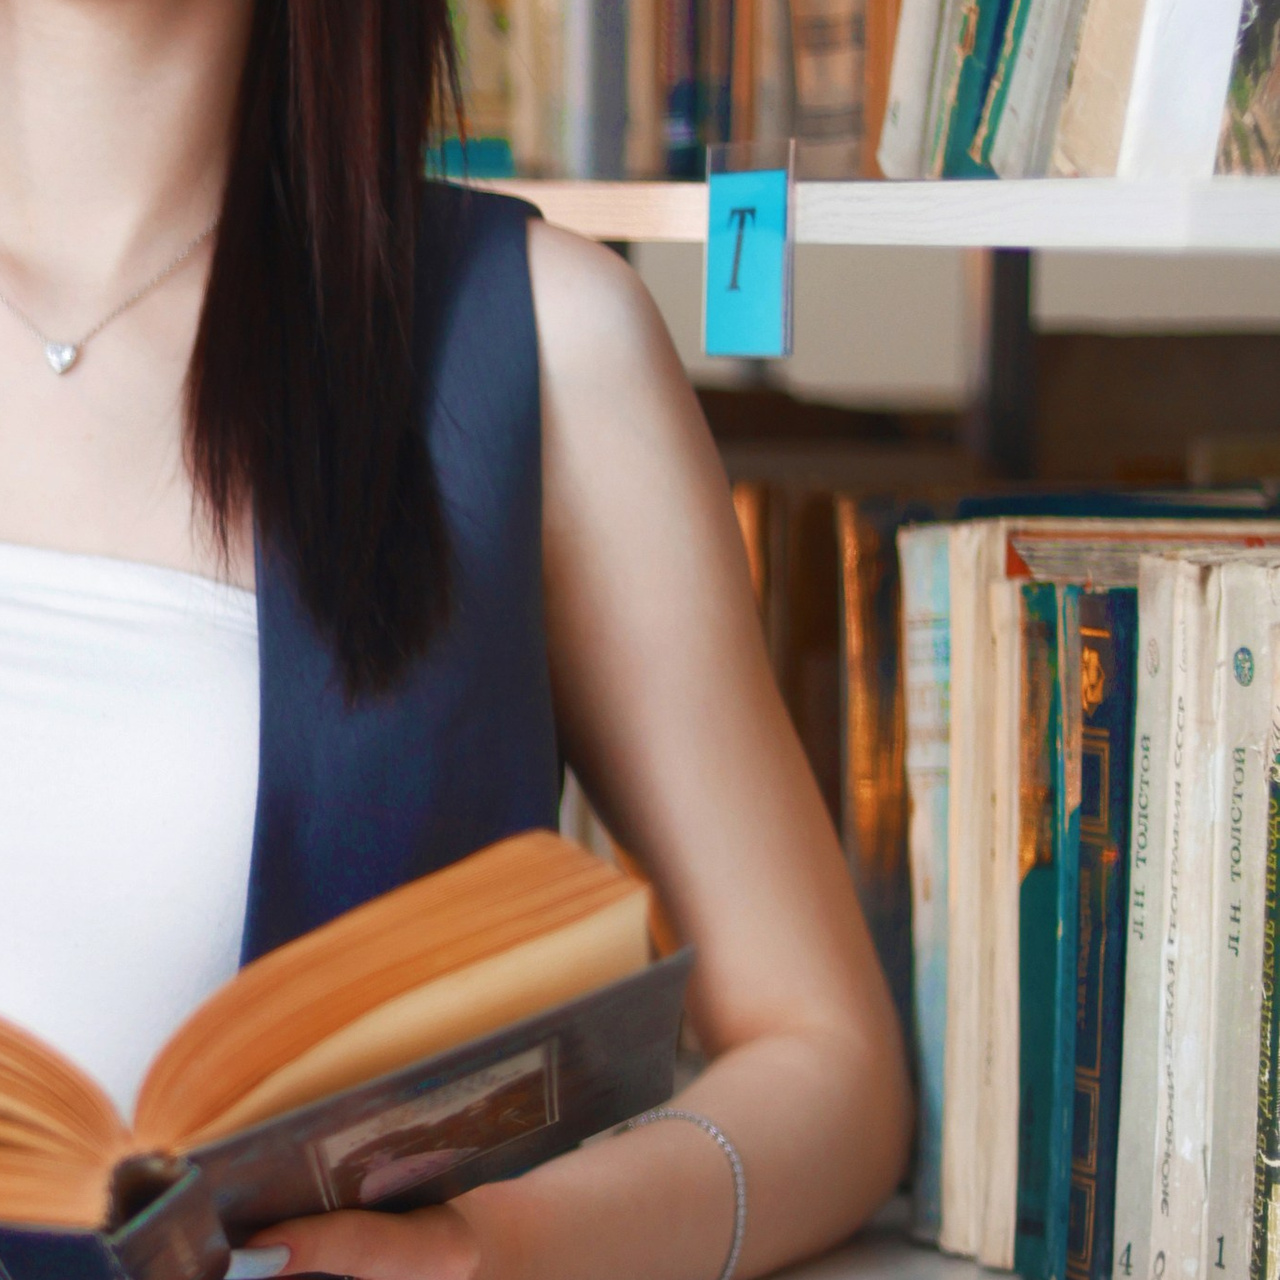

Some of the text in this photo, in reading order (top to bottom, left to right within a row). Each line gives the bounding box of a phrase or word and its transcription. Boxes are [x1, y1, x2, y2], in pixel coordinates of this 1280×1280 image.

[1135, 734, 1151, 869] ТОЛСТОЙ
[1230, 747, 1246, 882] ТОЛСТОЙ
[1160, 958, 1175, 1218] ЭКОНОМИЕСКАЯ
[1174, 695, 1186, 769] СССР
[1118, 1241, 1133, 1276] 4
[1214, 1235, 1225, 1270] 1
